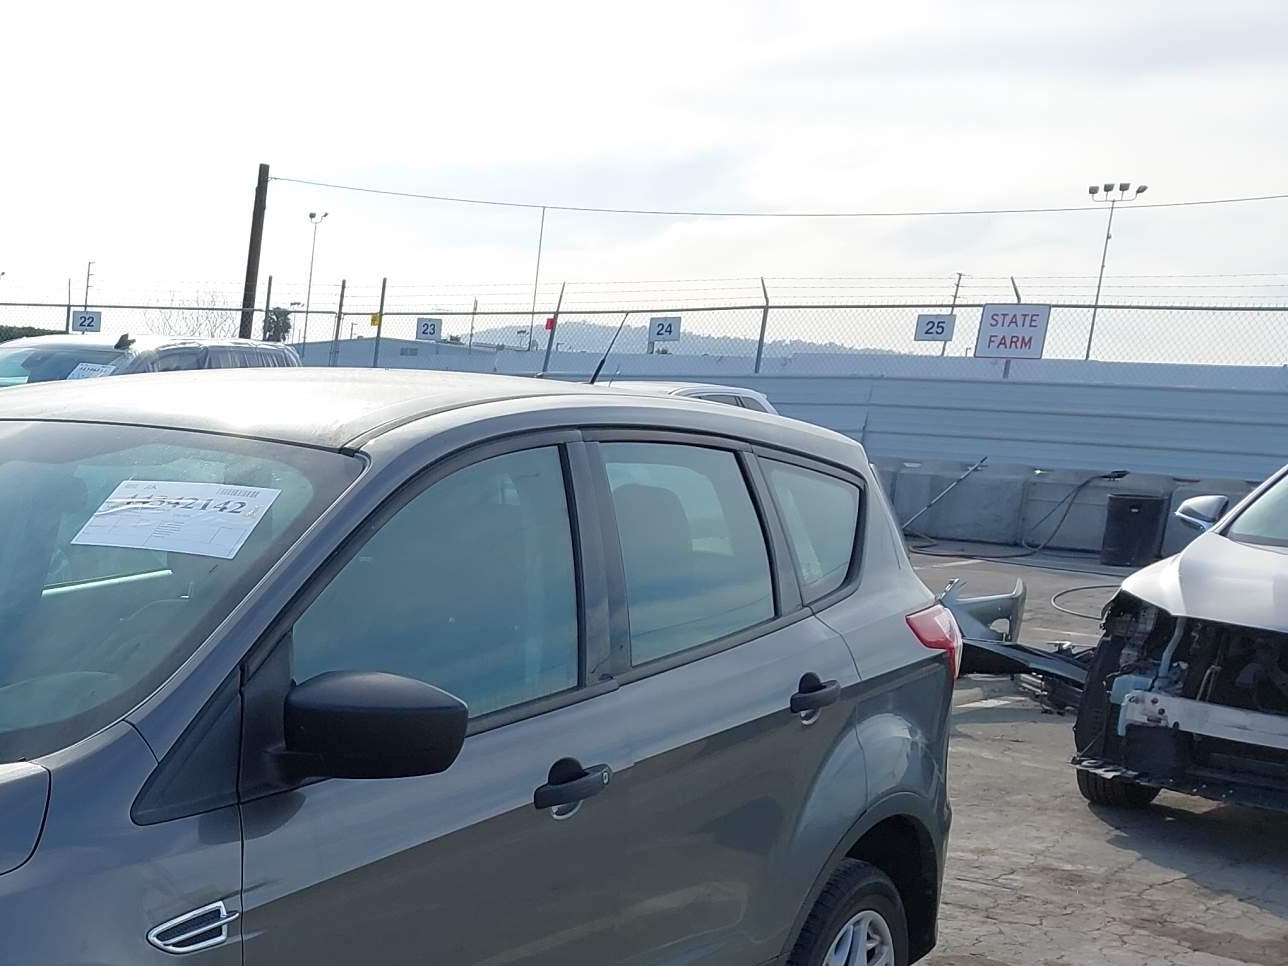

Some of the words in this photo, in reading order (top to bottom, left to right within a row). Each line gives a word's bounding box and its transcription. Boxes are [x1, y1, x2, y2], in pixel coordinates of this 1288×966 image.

[79, 316, 94, 328] 22
[989, 313, 1040, 328] STATE
[422, 323, 436, 335] 23
[656, 323, 673, 336] 24
[925, 321, 946, 335] 25
[987, 335, 1033, 350] FARM
